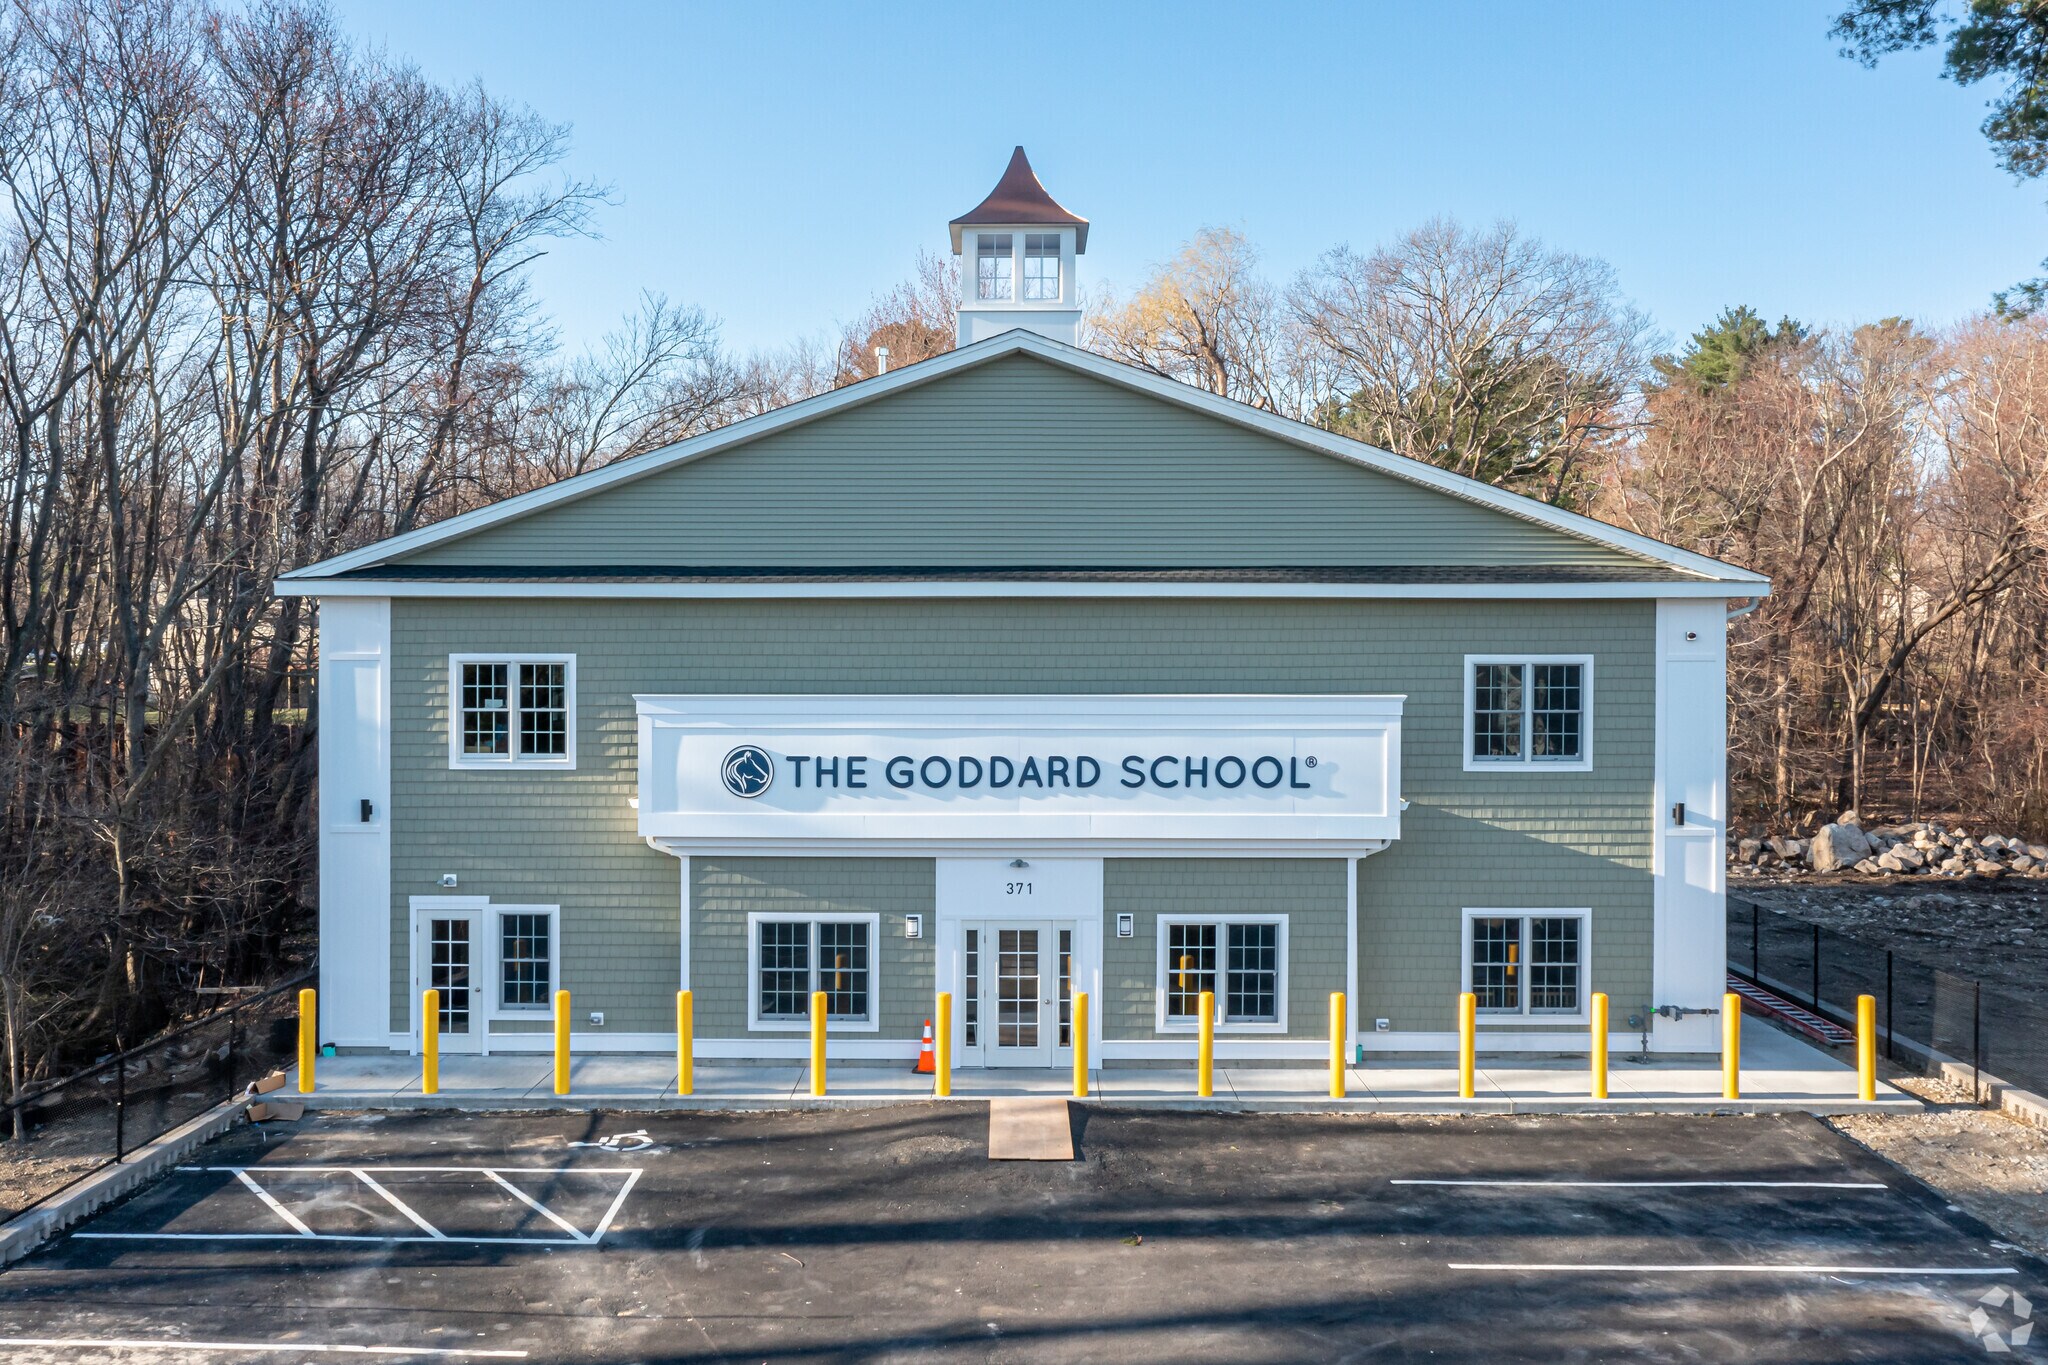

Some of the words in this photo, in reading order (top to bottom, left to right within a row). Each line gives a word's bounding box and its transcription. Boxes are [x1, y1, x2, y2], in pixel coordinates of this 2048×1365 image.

[785, 755, 868, 788] THE
[885, 755, 1101, 788] GODDARD
[1005, 882, 1033, 895] 371
